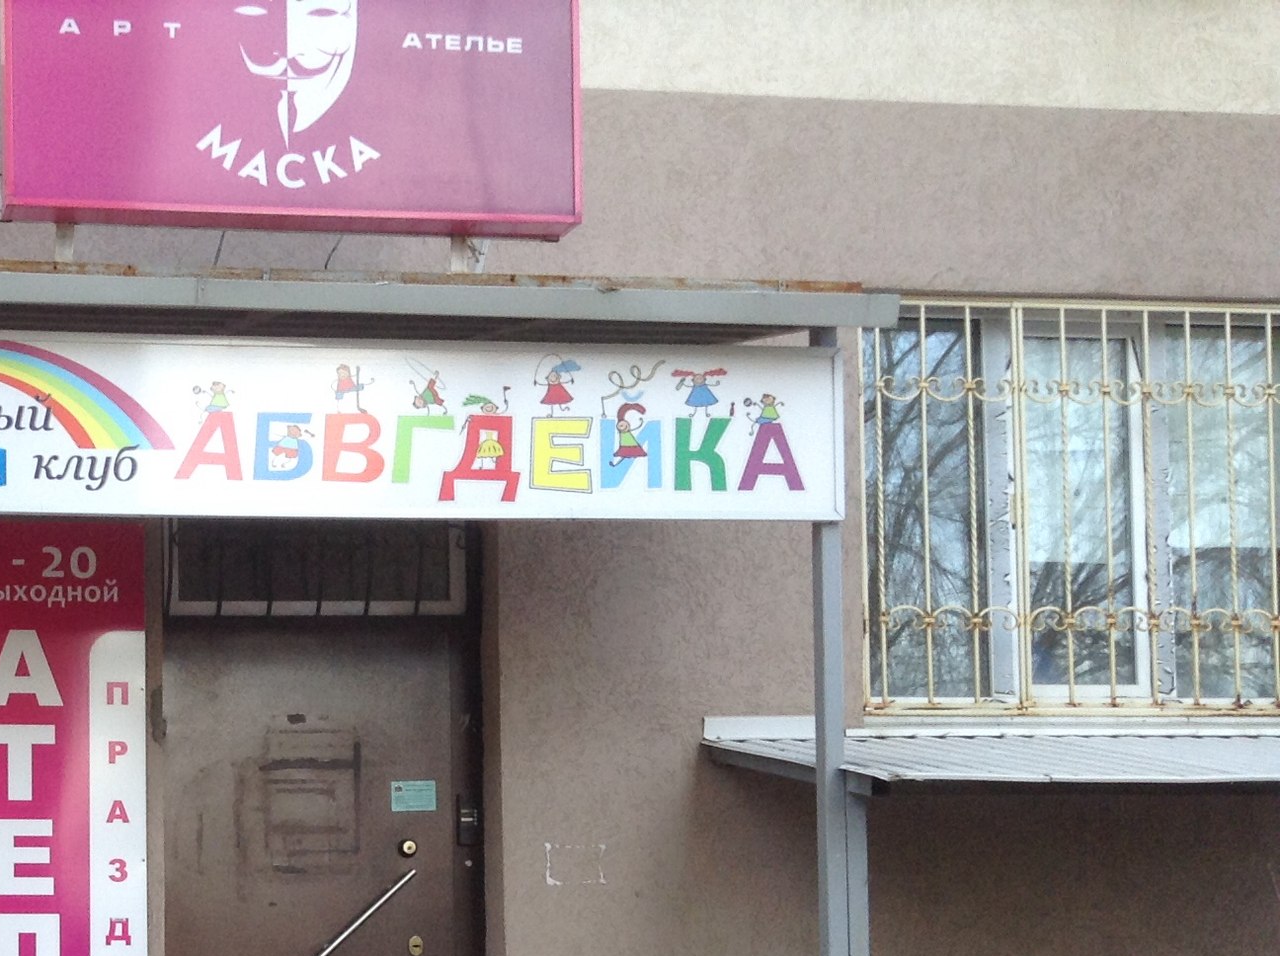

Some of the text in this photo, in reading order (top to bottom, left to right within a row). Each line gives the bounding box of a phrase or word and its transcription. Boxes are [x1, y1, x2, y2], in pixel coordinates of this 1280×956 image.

[402, 32, 523, 54] АТЕЛЬЕ
[196, 123, 381, 189] МАСКА
[33, 444, 140, 490] клуб
[174, 391, 805, 502] АБВГДЕЙКА
[41, 546, 97, 578] 20
